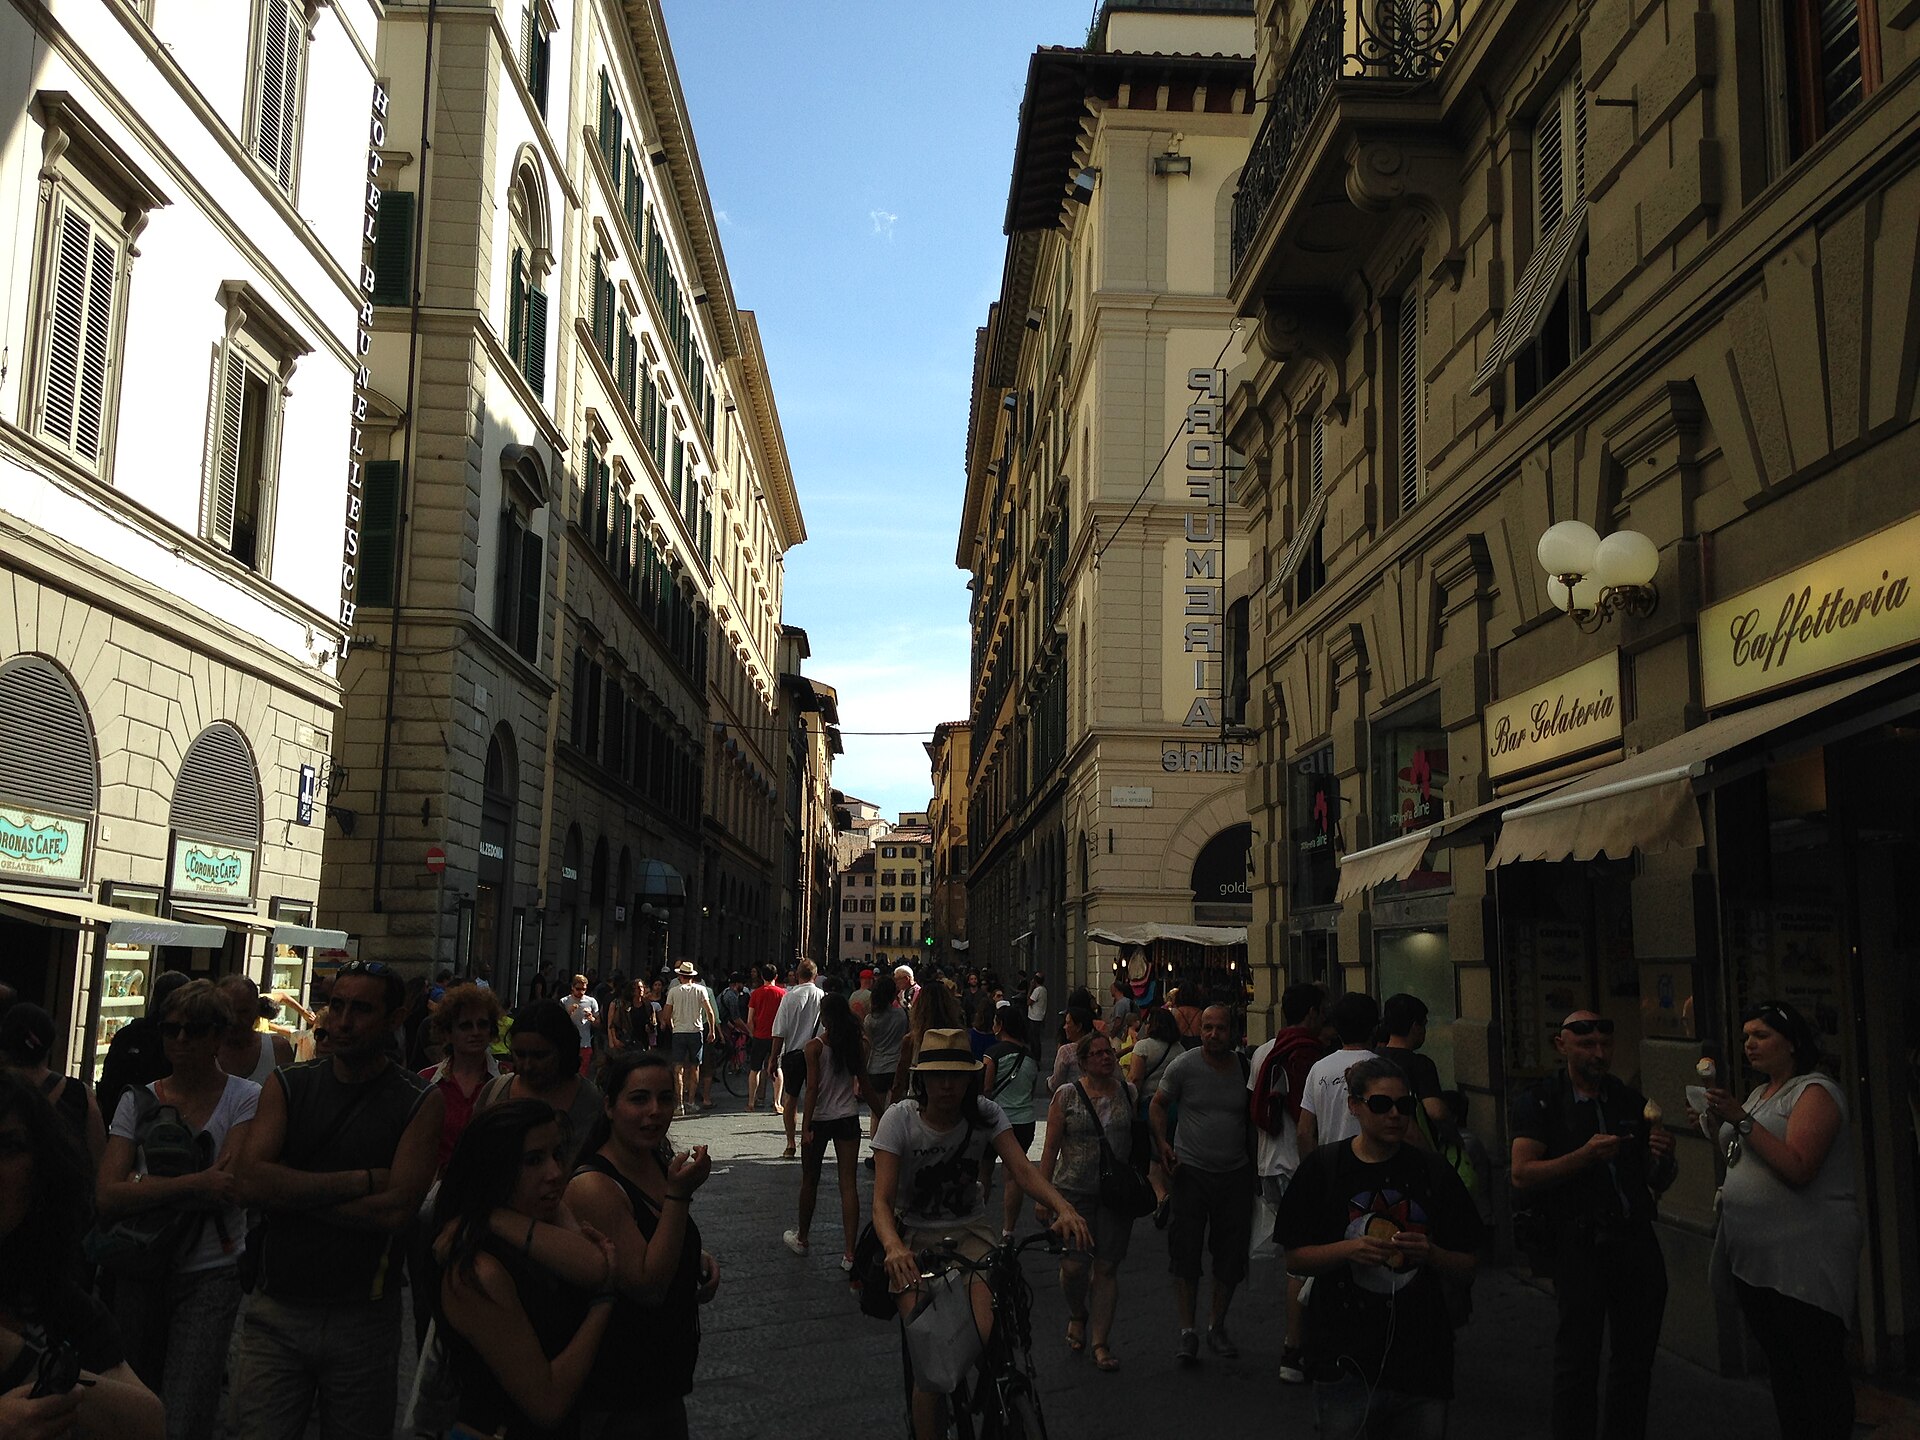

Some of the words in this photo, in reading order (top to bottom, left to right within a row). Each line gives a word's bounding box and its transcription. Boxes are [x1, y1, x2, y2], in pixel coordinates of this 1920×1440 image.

[365, 84, 390, 244] HOTEL
[340, 270, 376, 659] BRUNELLESCHI
[1730, 570, 1911, 673] Caffetteria
[1490, 716, 1527, 758] Bar
[1530, 689, 1615, 743] Gelateria
[1, 860, 45, 873] GELATERIA
[190, 856, 219, 878] CORONAS
